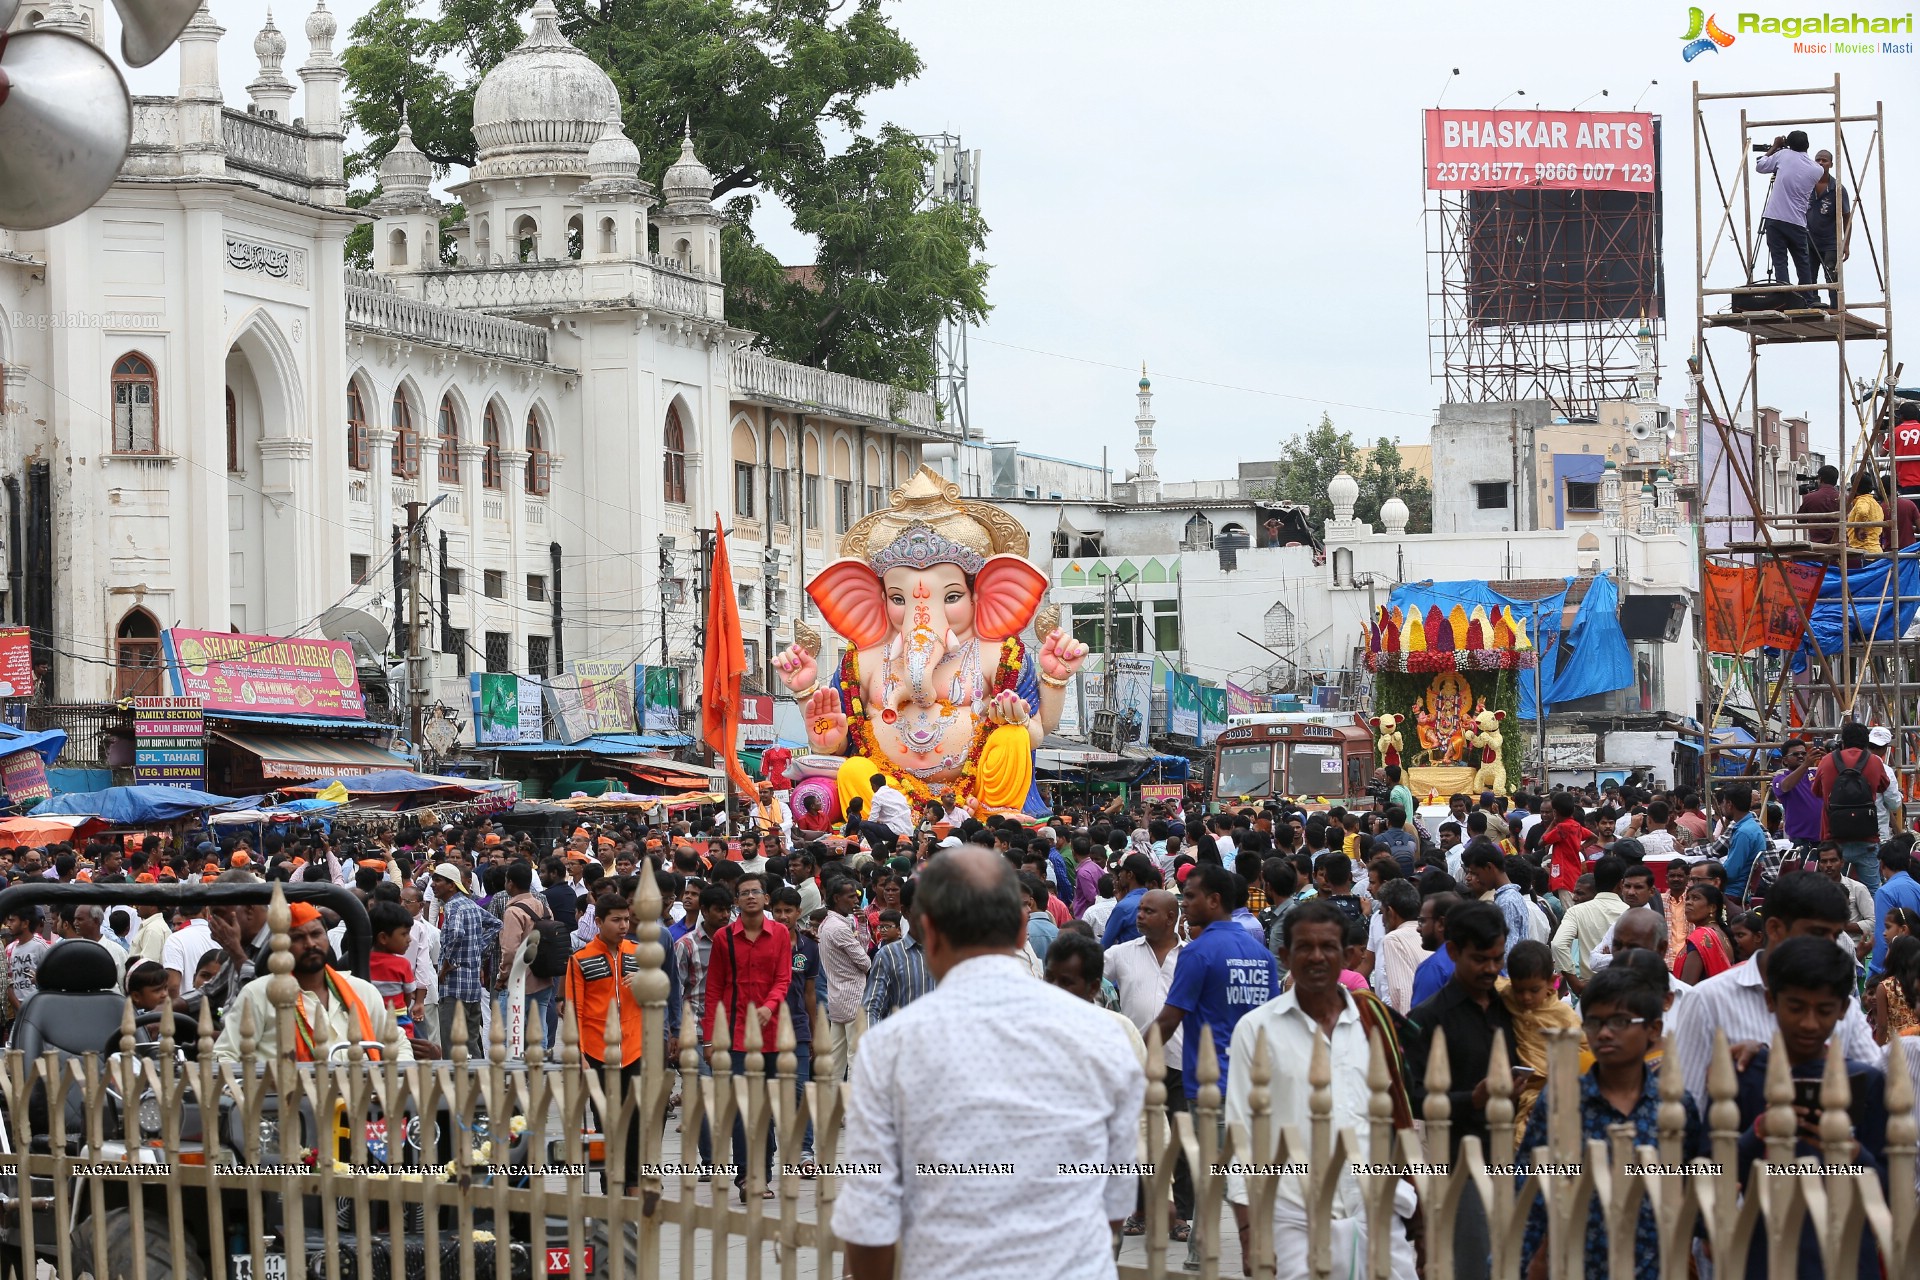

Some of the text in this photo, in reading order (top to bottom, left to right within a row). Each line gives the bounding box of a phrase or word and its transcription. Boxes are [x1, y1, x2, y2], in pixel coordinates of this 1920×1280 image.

[1443, 120, 1643, 149] BHASKAR ARTS
[1437, 162, 1653, 184] 23731577, 9866 007 123
[203, 637, 332, 668] SHAMS BIRYANI DARBAR
[136, 697, 202, 708] SHAM'S HOTEL
[135, 711, 202, 719] FAMILY SECTION
[135, 725, 152, 733] SPL.
[1225, 727, 1253, 739] GOODS
[137, 739, 150, 747] DUM
[151, 739, 175, 747] BIRYANI
[1, 751, 37, 766] CHICKEN
[138, 754, 160, 762] SPL.
[5, 760, 37, 774] BIRYANI
[138, 768, 201, 776] VEG. BIRYANI
[305, 766, 335, 776] SHAMS
[337, 767, 363, 777] HOTEL
[10, 784, 48, 799] KALYANI
[1142, 787, 1181, 796] MILAN JUICE
[1229, 969, 1270, 985] POICE
